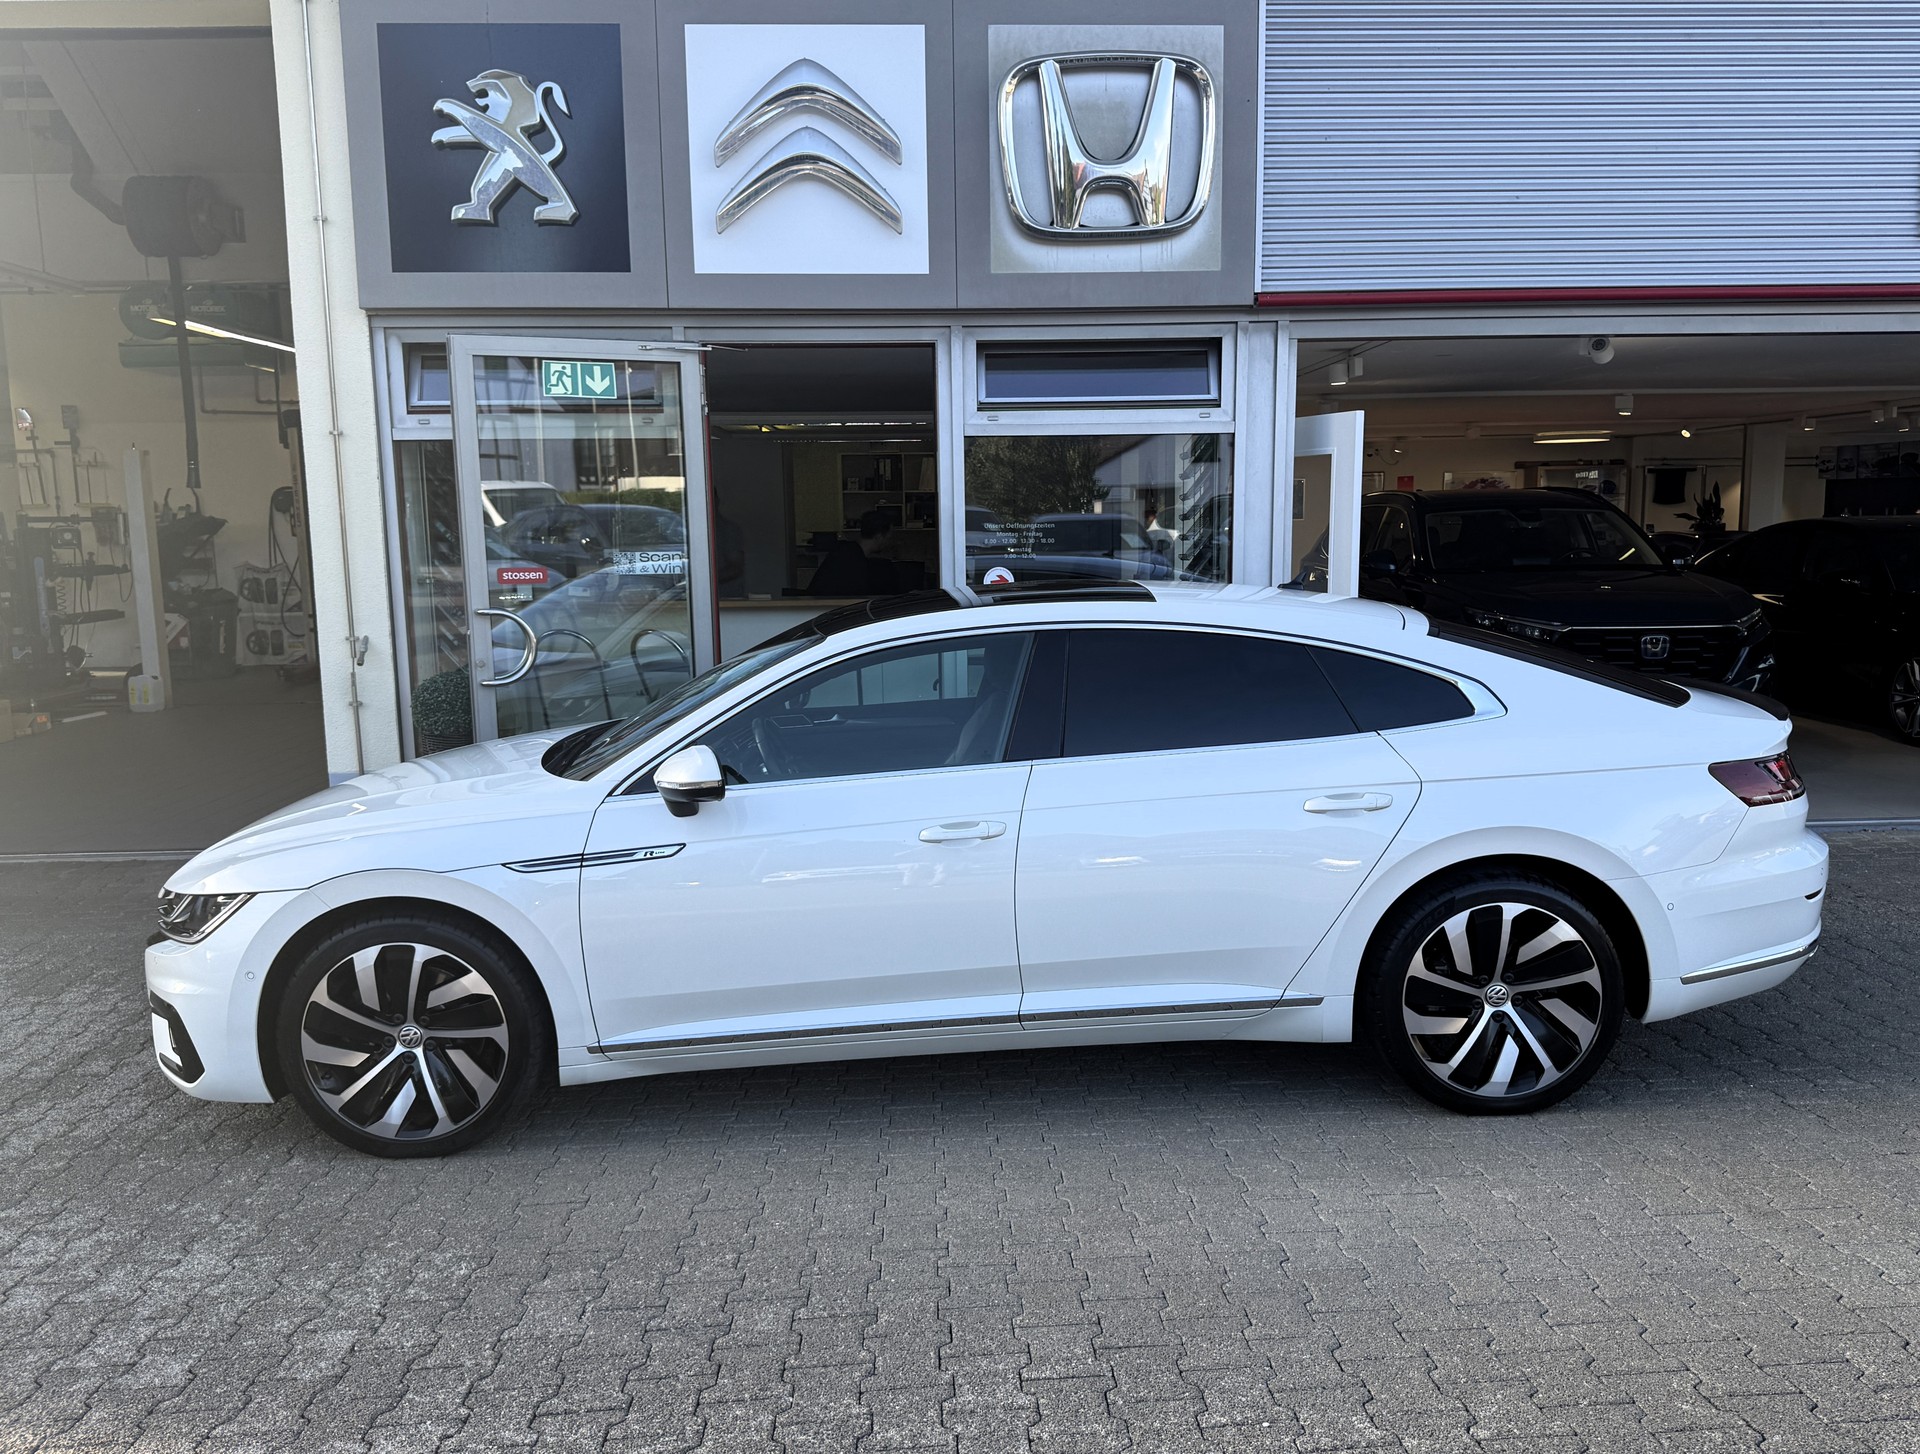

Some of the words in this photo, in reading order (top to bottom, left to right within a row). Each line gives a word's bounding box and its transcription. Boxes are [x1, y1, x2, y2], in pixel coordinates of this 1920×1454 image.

[639, 552, 682, 562] Scan
[639, 565, 650, 573] &
[651, 562, 683, 574] Win
[502, 570, 543, 580] stossen
